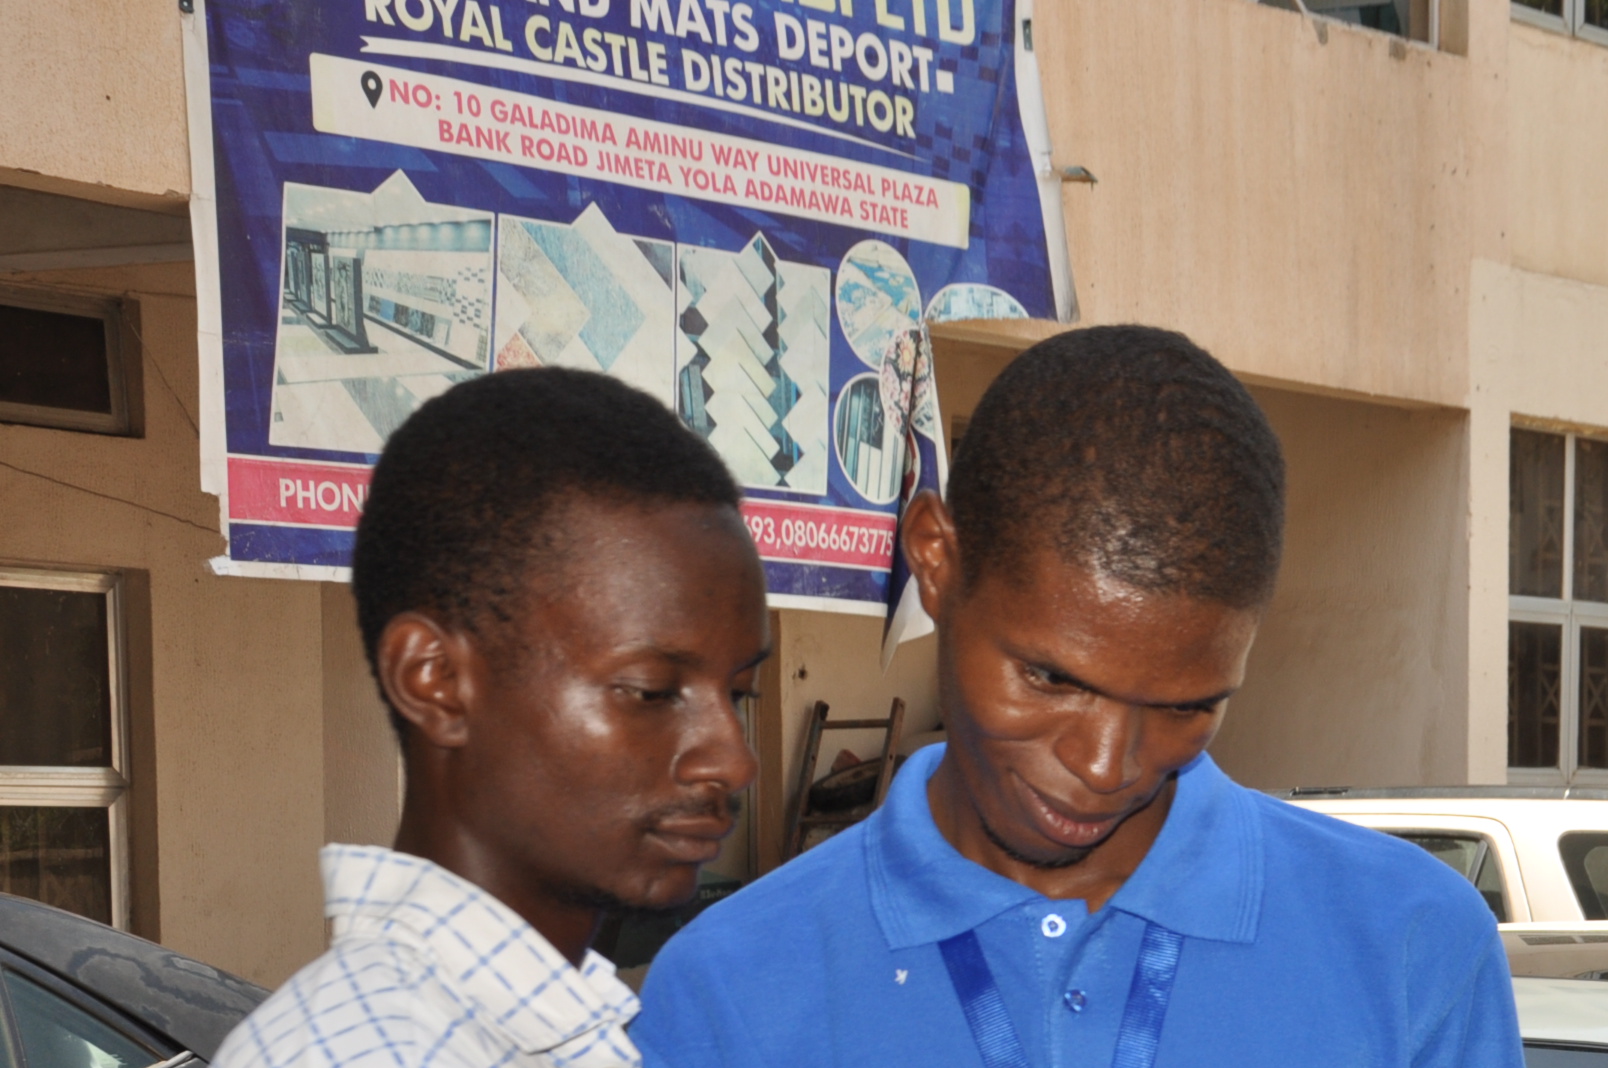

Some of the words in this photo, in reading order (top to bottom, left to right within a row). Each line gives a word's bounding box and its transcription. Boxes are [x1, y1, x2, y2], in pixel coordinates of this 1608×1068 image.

[364, 0, 513, 52] ROYAL
[524, 14, 670, 86] CASTLE
[681, 48, 917, 139] DISTRIBUTOR
[630, 0, 760, 52] MATS
[389, 79, 441, 111] NO:
[453, 91, 482, 118] 10
[490, 99, 617, 146] GALADIMA
[625, 127, 703, 162] AMINU
[711, 142, 760, 173] WAY
[767, 153, 876, 196] UNIVERSAL
[881, 177, 939, 209] PLAZA
[438, 119, 513, 154] BANK
[520, 134, 588, 168] ROAD
[596, 150, 673, 186] JIMETA
[679, 164, 738, 197] YOLA
[744, 177, 854, 219] ADAMAWA
[859, 200, 909, 229] STATE
